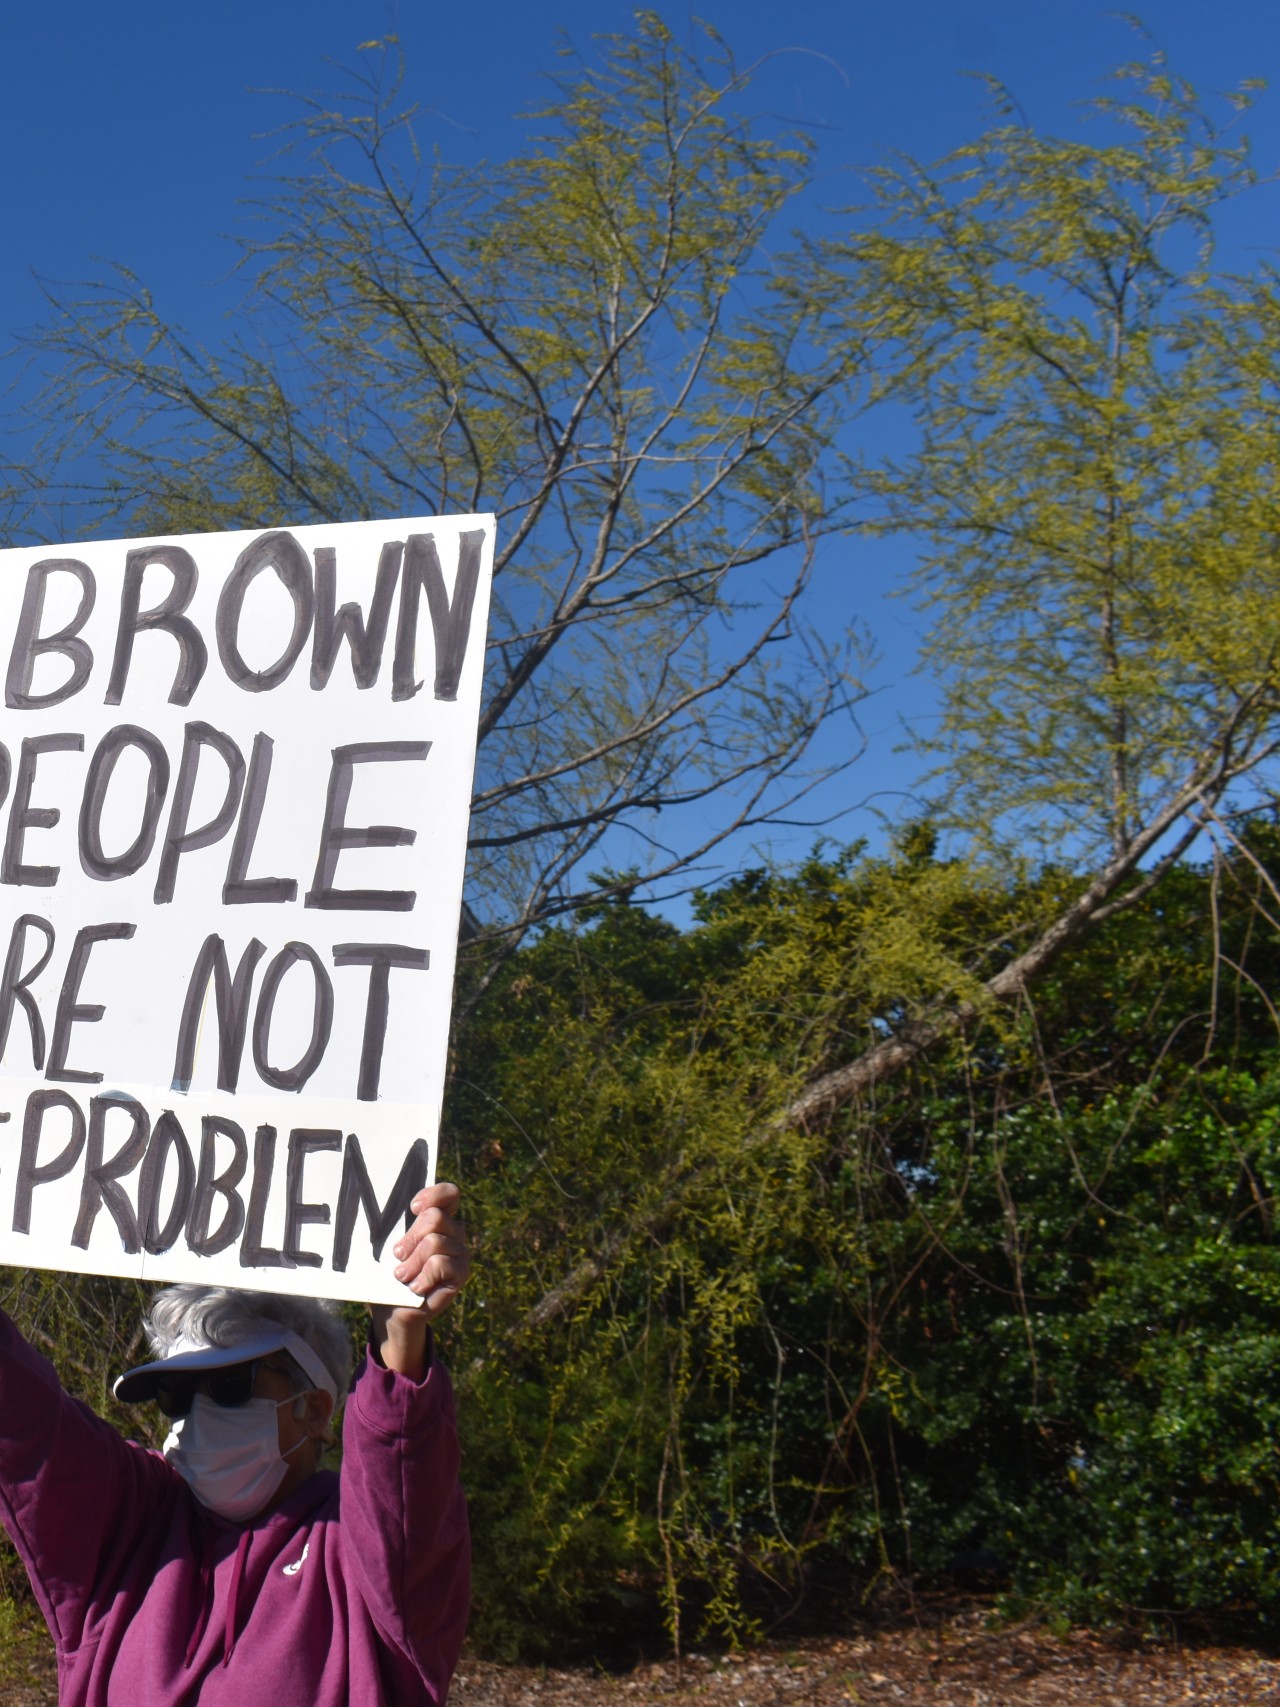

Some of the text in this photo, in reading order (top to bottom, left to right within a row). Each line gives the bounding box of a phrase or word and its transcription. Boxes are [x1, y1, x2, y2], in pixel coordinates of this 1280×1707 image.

[5, 529, 486, 710] BROWN
[169, 932, 431, 1102] NOT
[12, 1088, 429, 1273] PROBLEM
